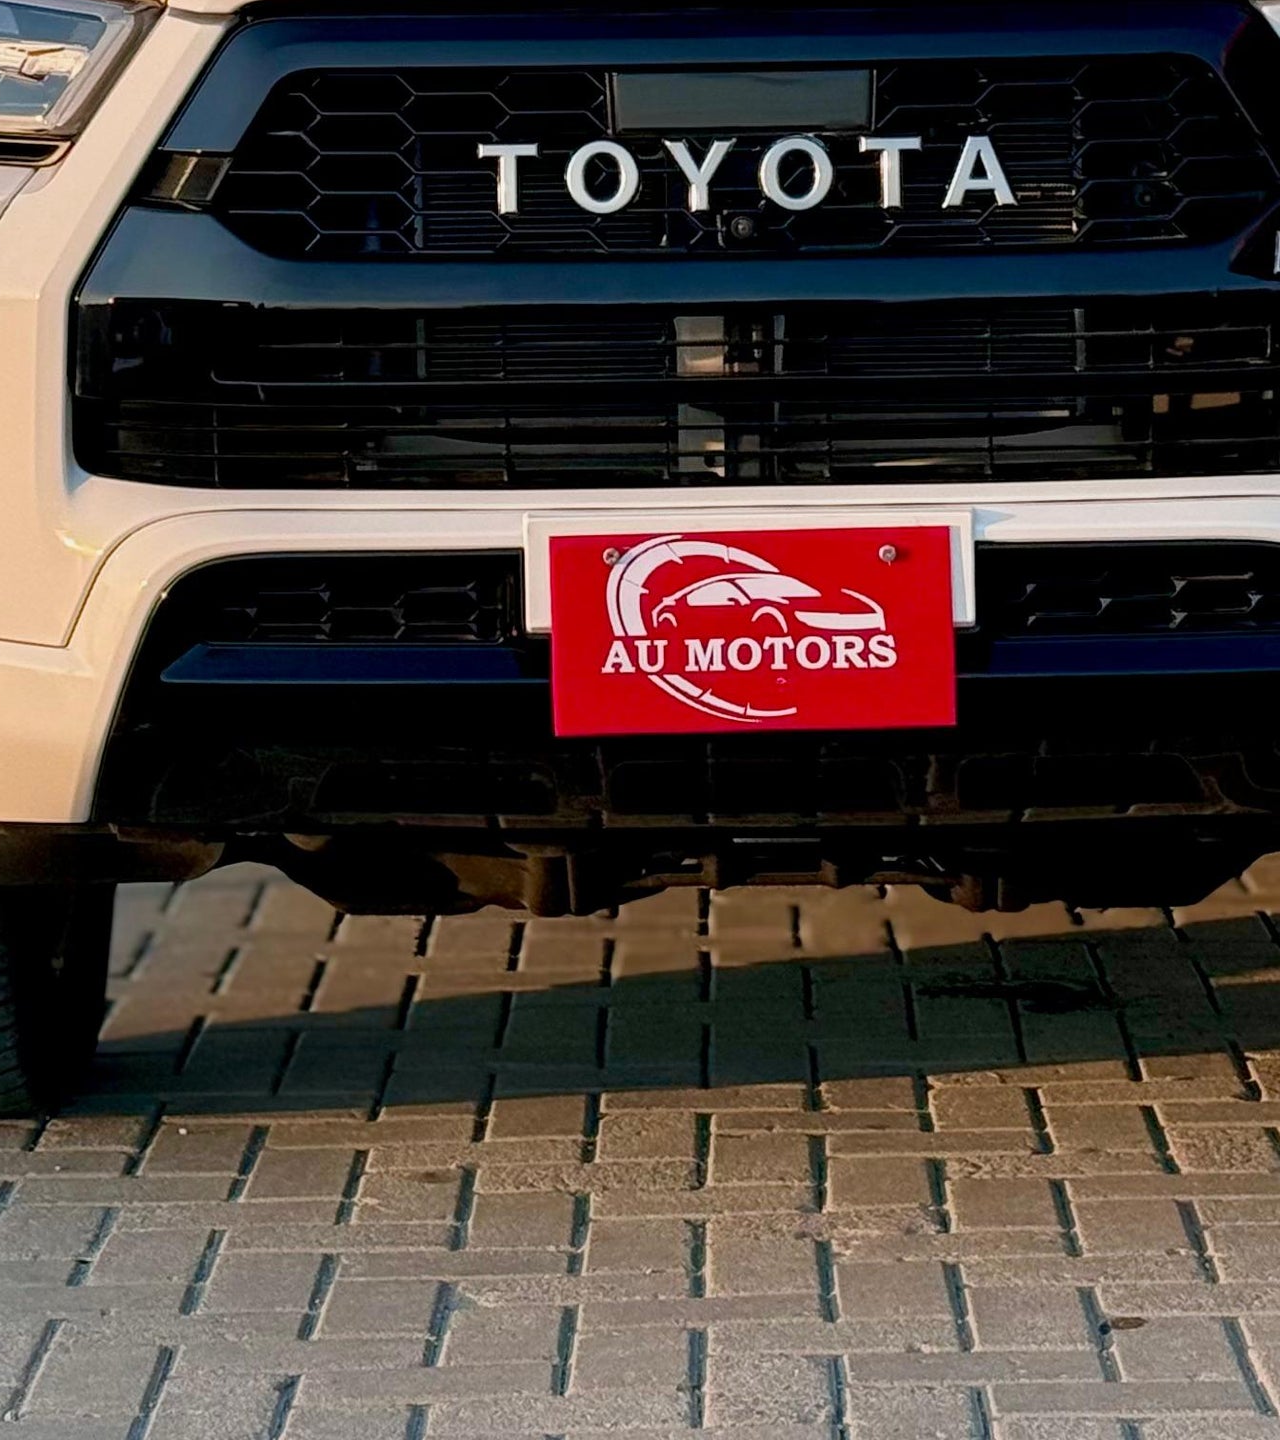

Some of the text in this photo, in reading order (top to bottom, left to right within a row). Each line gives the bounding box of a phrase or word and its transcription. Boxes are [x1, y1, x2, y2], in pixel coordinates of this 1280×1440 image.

[477, 135, 1018, 215] TOYOTA
[601, 634, 898, 673] AU MOTORS
